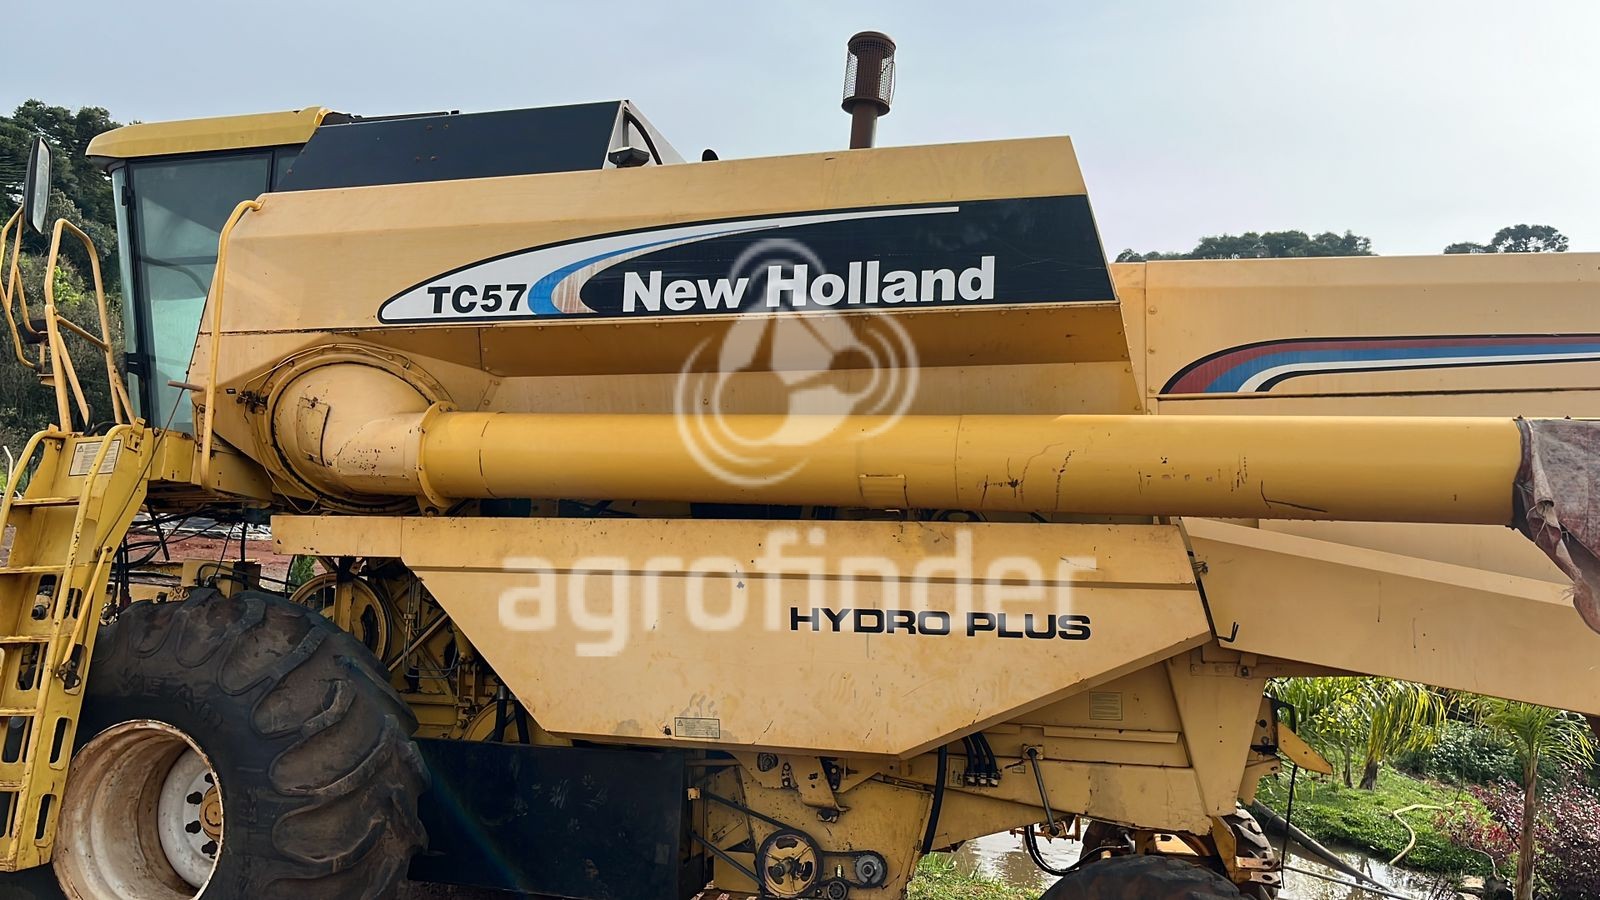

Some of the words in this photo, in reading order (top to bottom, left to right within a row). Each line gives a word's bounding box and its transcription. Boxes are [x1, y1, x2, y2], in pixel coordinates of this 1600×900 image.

[427, 283, 528, 314] TC57
[622, 270, 750, 313] New
[766, 255, 996, 308] Holland
[790, 606, 951, 636] HYDRO
[966, 611, 1092, 641] PLUS
